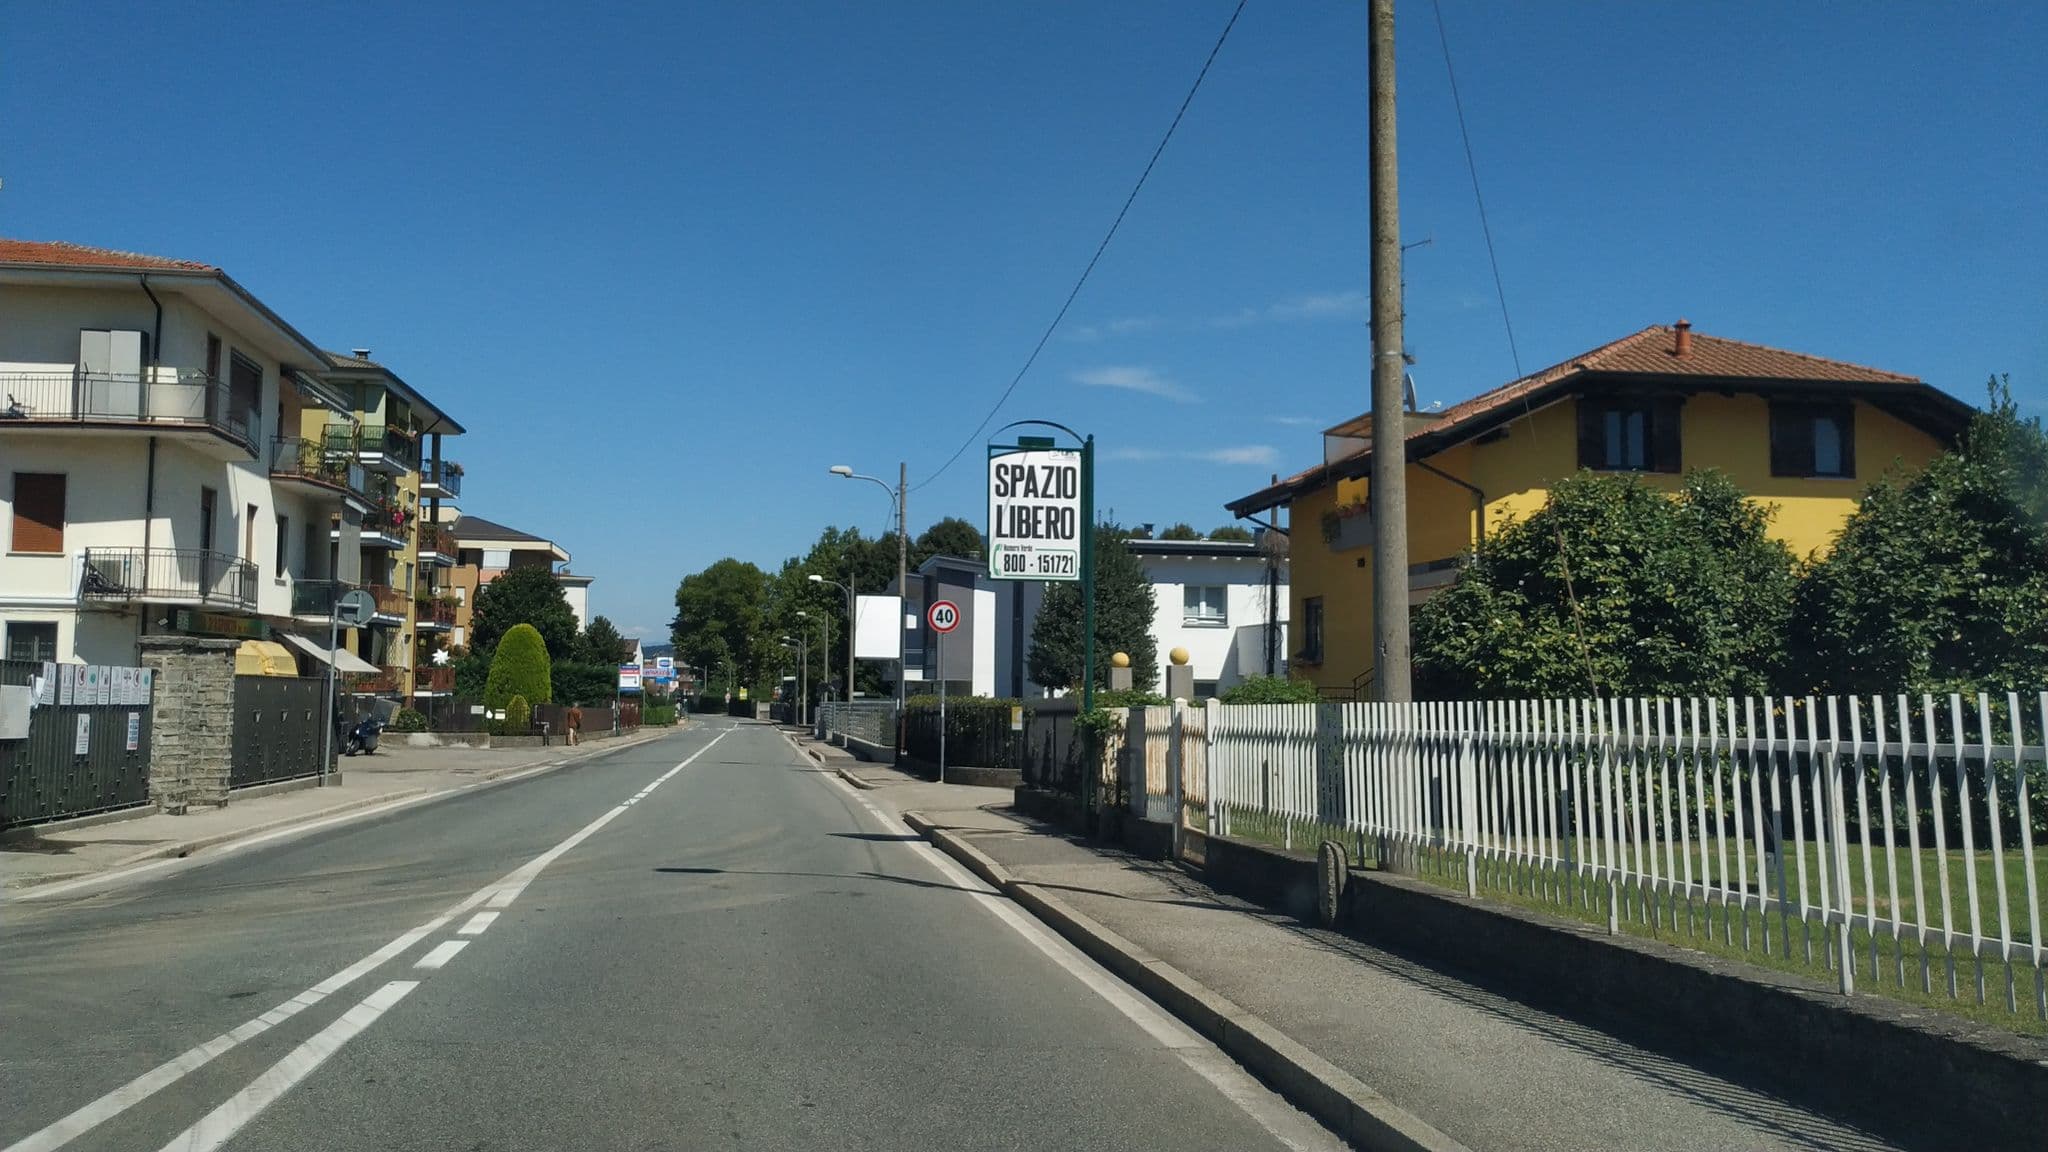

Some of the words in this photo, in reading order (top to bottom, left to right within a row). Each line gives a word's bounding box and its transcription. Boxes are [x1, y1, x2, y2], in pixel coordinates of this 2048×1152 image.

[995, 463, 1077, 500] SPAZIO
[995, 504, 1075, 540] LIBERO
[1003, 554, 1026, 573] 800
[1037, 555, 1074, 574] 151721
[935, 609, 954, 624] 40
